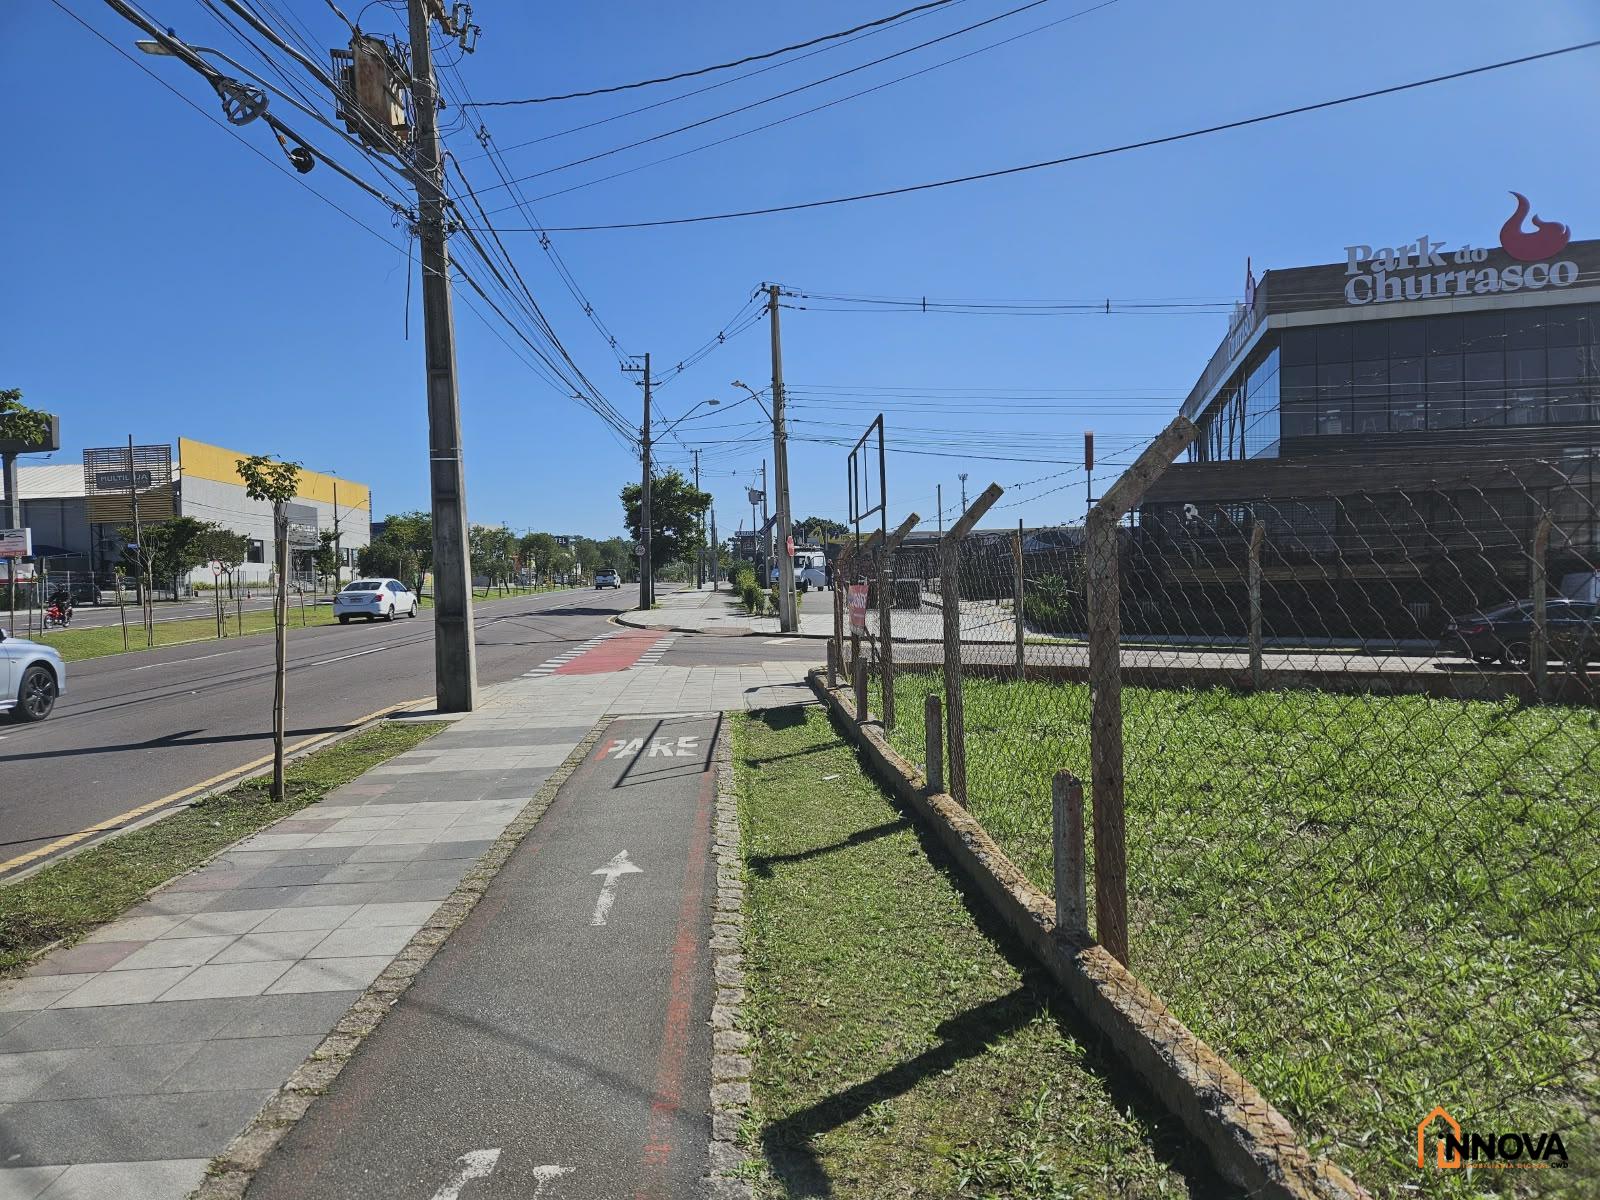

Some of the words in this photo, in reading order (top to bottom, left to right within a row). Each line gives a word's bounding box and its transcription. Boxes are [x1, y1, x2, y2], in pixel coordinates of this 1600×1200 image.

[1344, 235, 1447, 275] Park
[1454, 244, 1489, 265] do
[1344, 260, 1580, 305] Churrasco
[100, 473, 148, 482] MULTILJA
